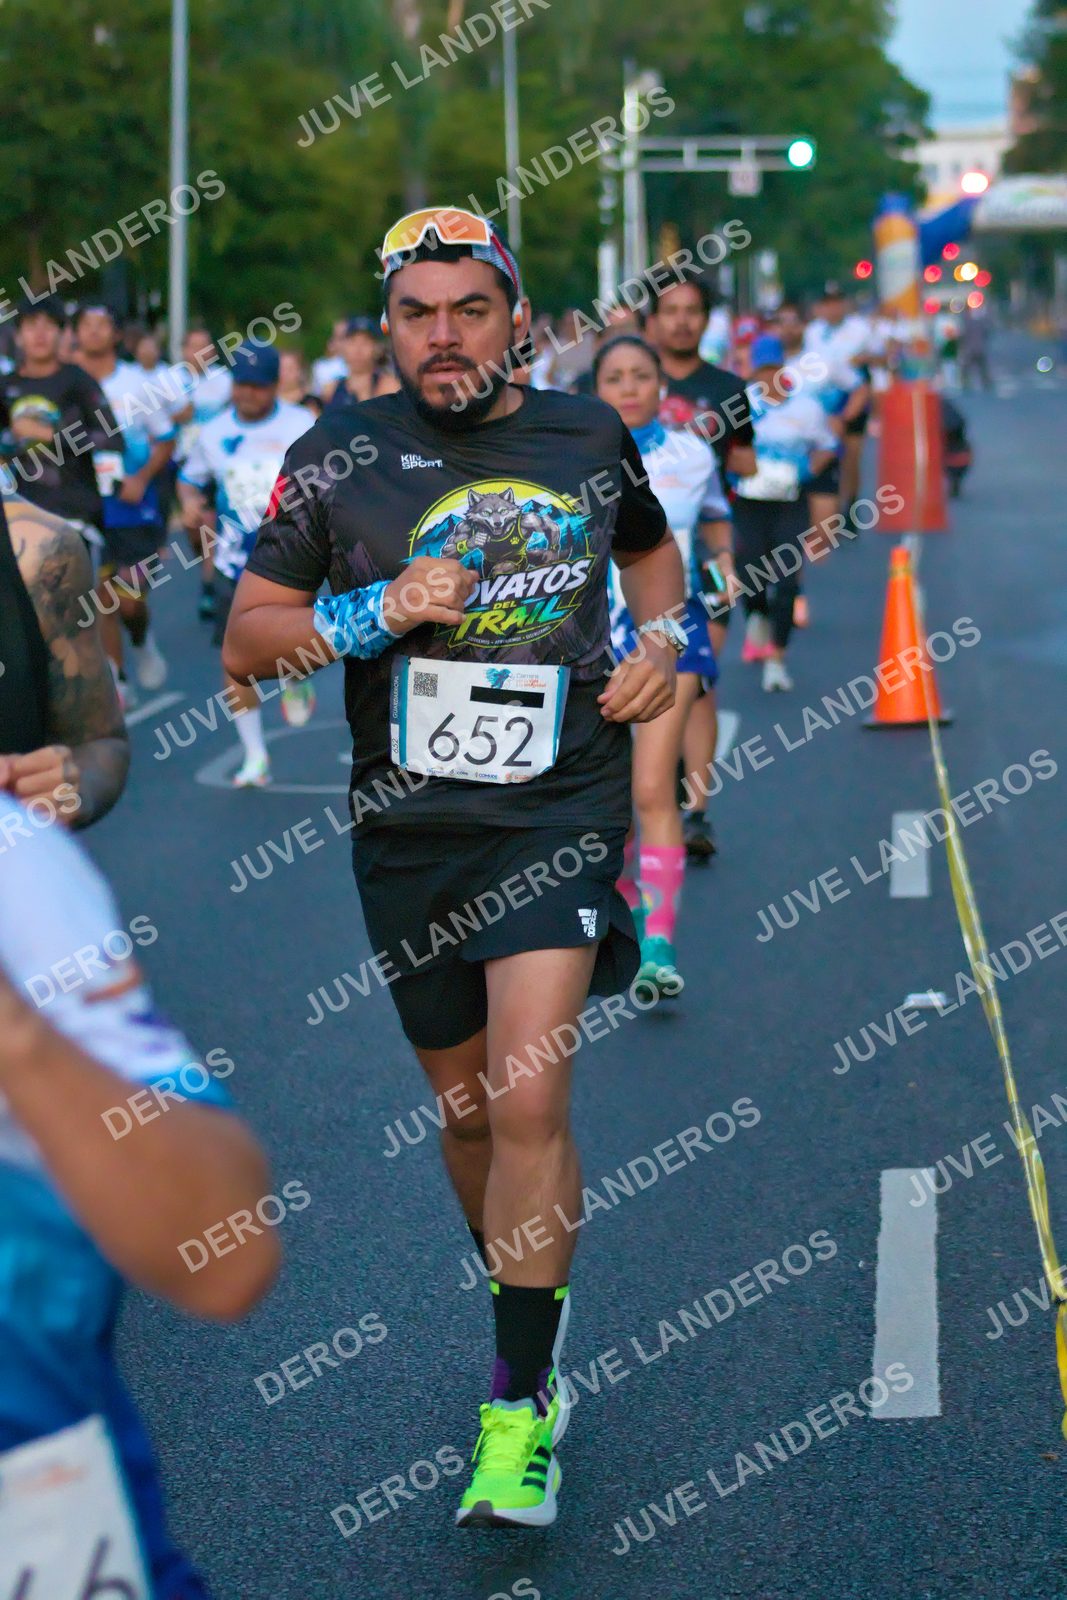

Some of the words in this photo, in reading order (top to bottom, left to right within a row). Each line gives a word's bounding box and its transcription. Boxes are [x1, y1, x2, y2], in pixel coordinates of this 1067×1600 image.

[464, 559, 593, 608] VATOS
[492, 599, 517, 611] DEL
[453, 594, 570, 641] TRAIL
[428, 712, 534, 767] 652
